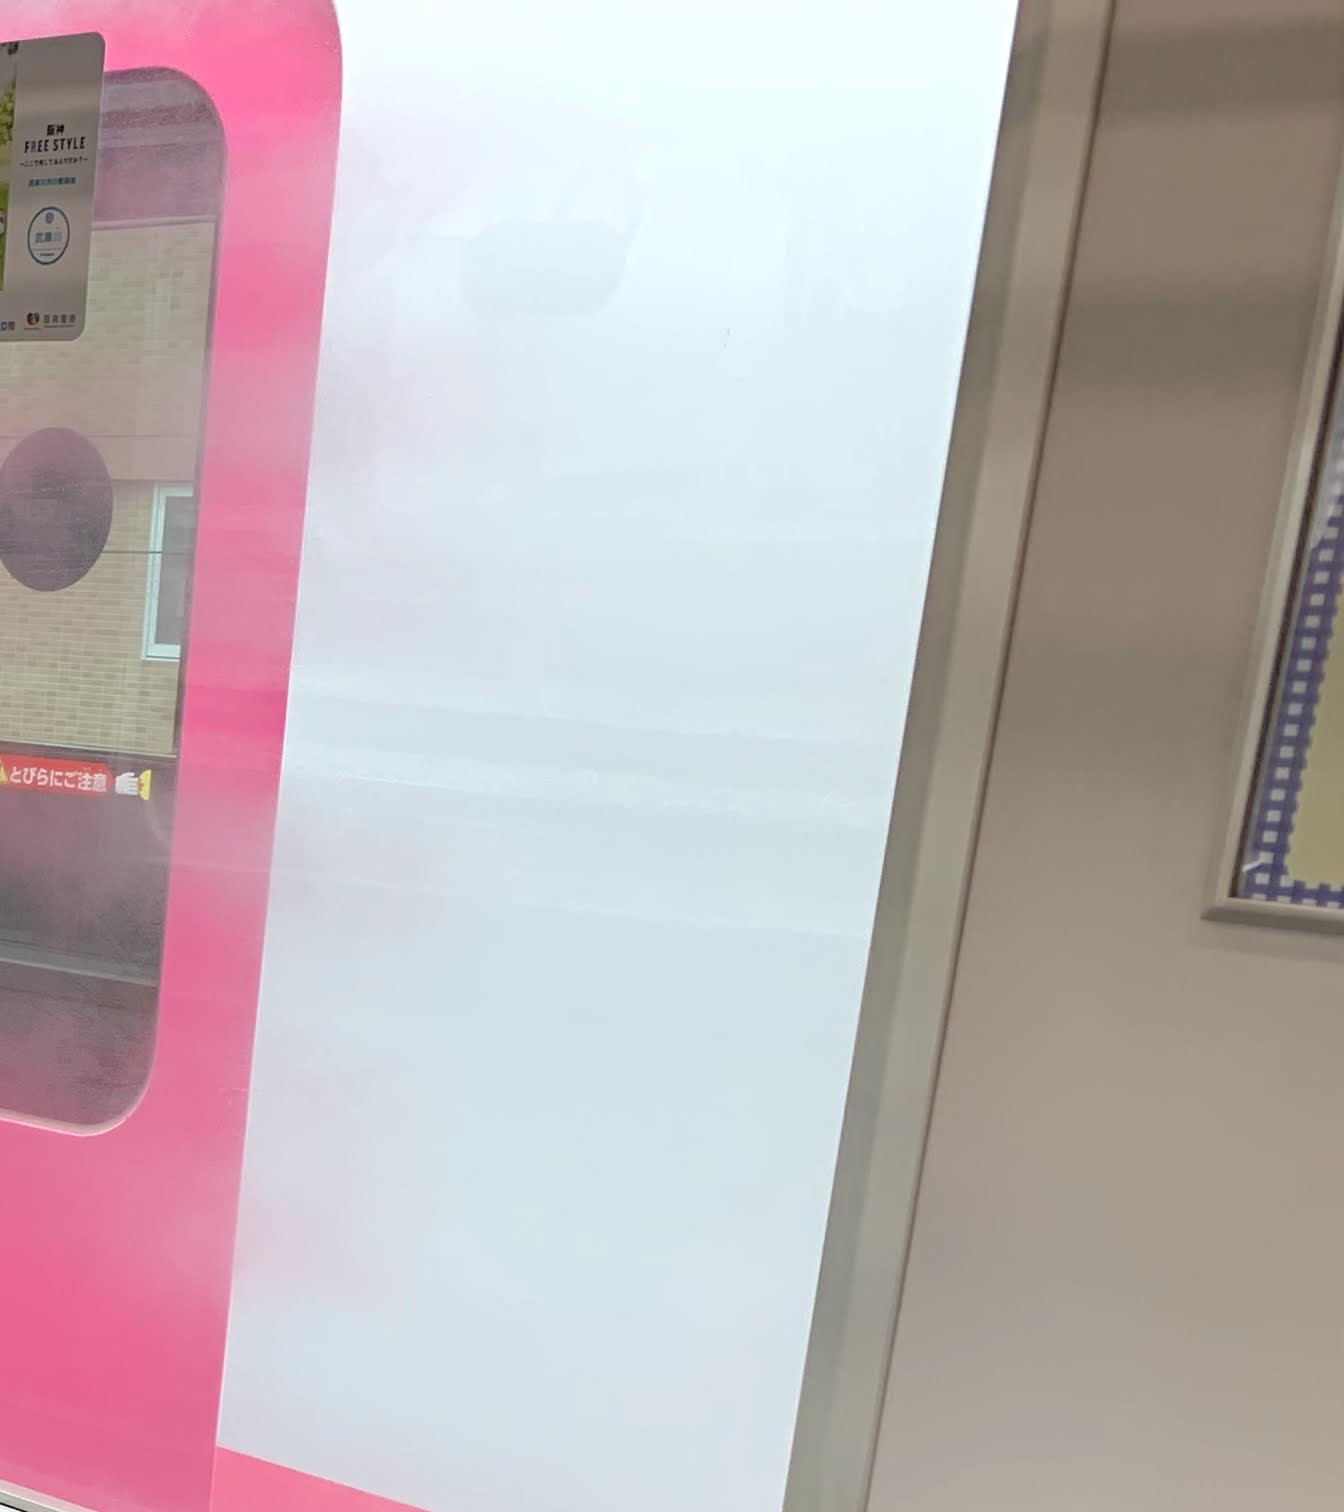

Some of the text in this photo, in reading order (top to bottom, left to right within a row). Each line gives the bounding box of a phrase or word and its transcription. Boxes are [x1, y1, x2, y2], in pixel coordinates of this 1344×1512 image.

[24, 136, 86, 153] FREE STYLE
[9, 765, 108, 793] とびらにご注意
